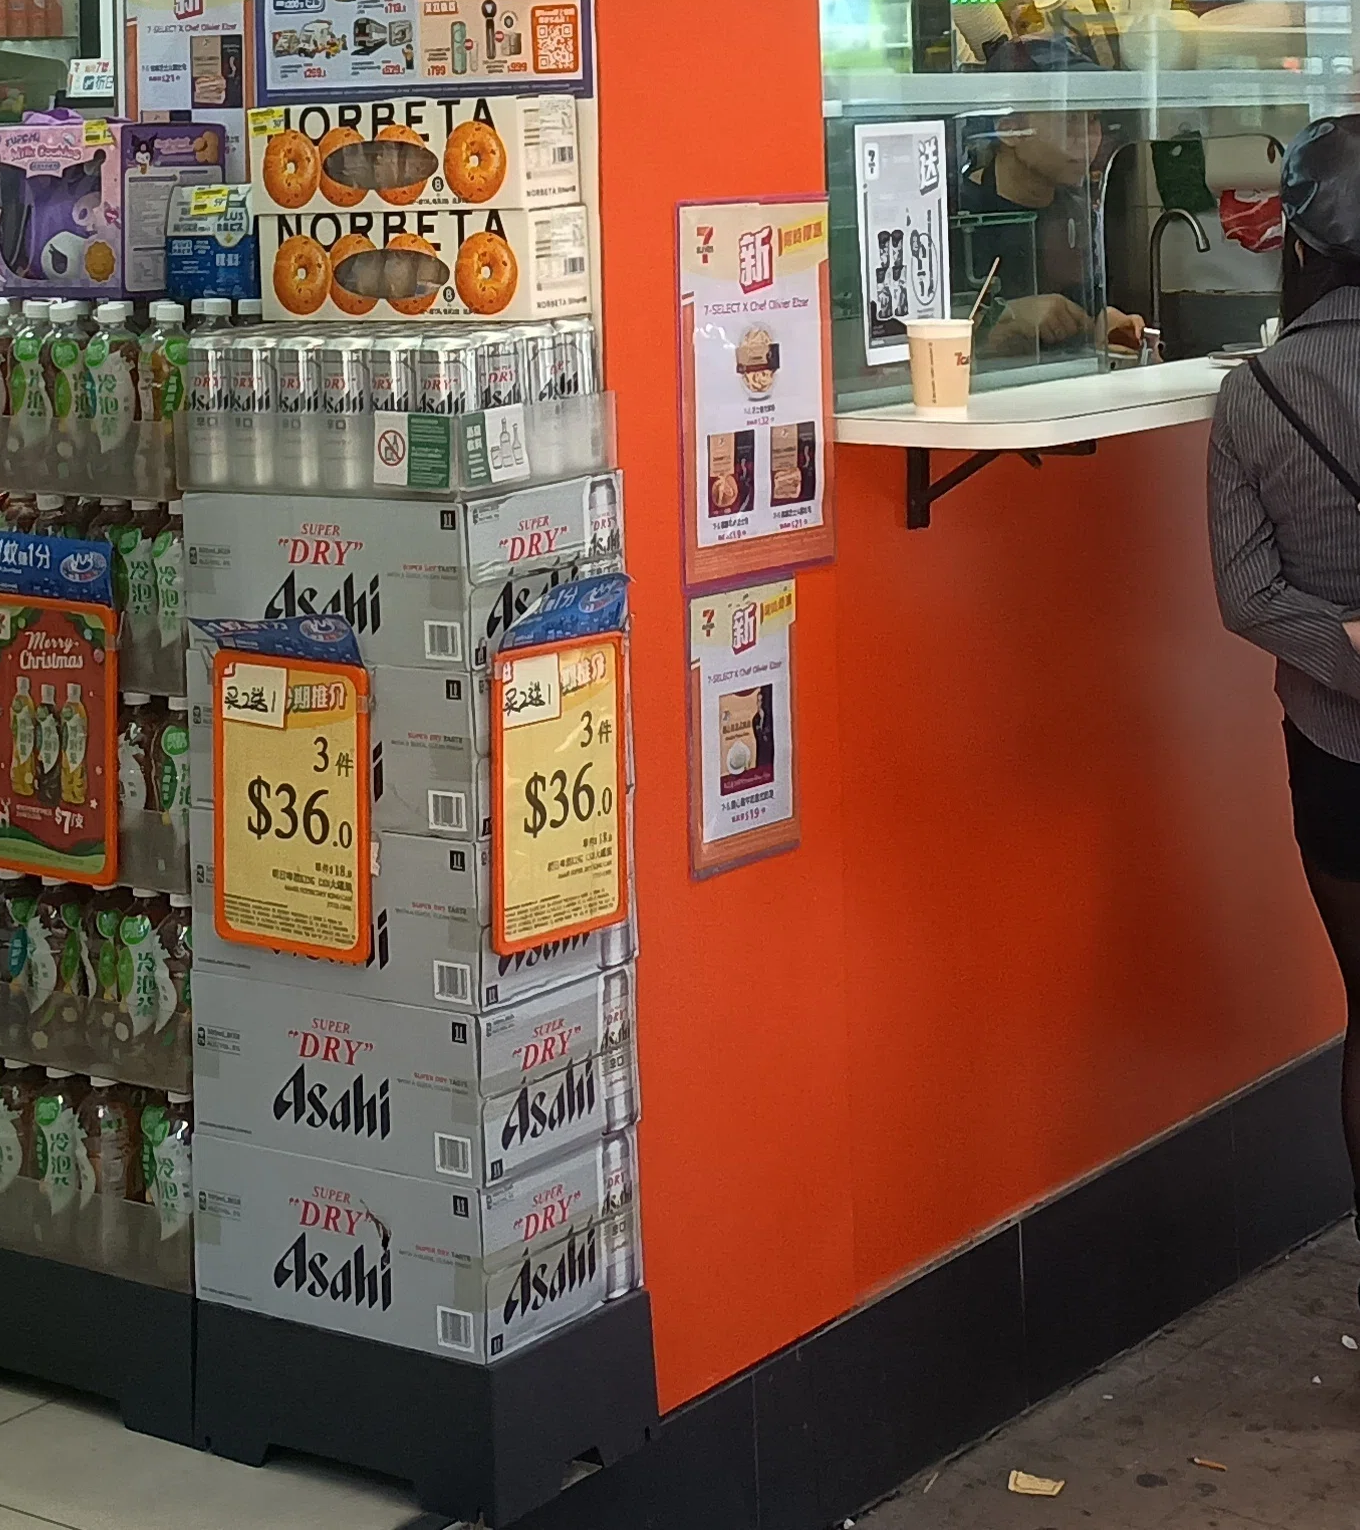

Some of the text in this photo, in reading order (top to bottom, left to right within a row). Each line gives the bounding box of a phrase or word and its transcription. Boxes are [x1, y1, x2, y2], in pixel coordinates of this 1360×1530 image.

[277, 208, 509, 253] NORBETA
[739, 225, 773, 289] 新
[300, 522, 341, 537] SUPER
[516, 514, 551, 531] SUPER
[263, 569, 382, 637] Asahi
[24, 631, 80, 654] Merry
[732, 601, 757, 651] 新
[20, 649, 84, 671] Christmas
[286, 682, 347, 713] 期推介
[580, 710, 613, 748] 3 件
[313, 736, 354, 778] 3 件
[247, 775, 354, 850] $36.0
[523, 760, 613, 839] $36.0
[312, 1017, 351, 1035] SUPER
[532, 1017, 565, 1037] SUPER
[273, 1062, 392, 1141] Asahi
[500, 1052, 597, 1152] Asahi
[312, 1185, 351, 1205] SUPER
[532, 1184, 565, 1208] SUPER
[273, 1232, 392, 1312] Asahi
[502, 1220, 597, 1327] Asahi
